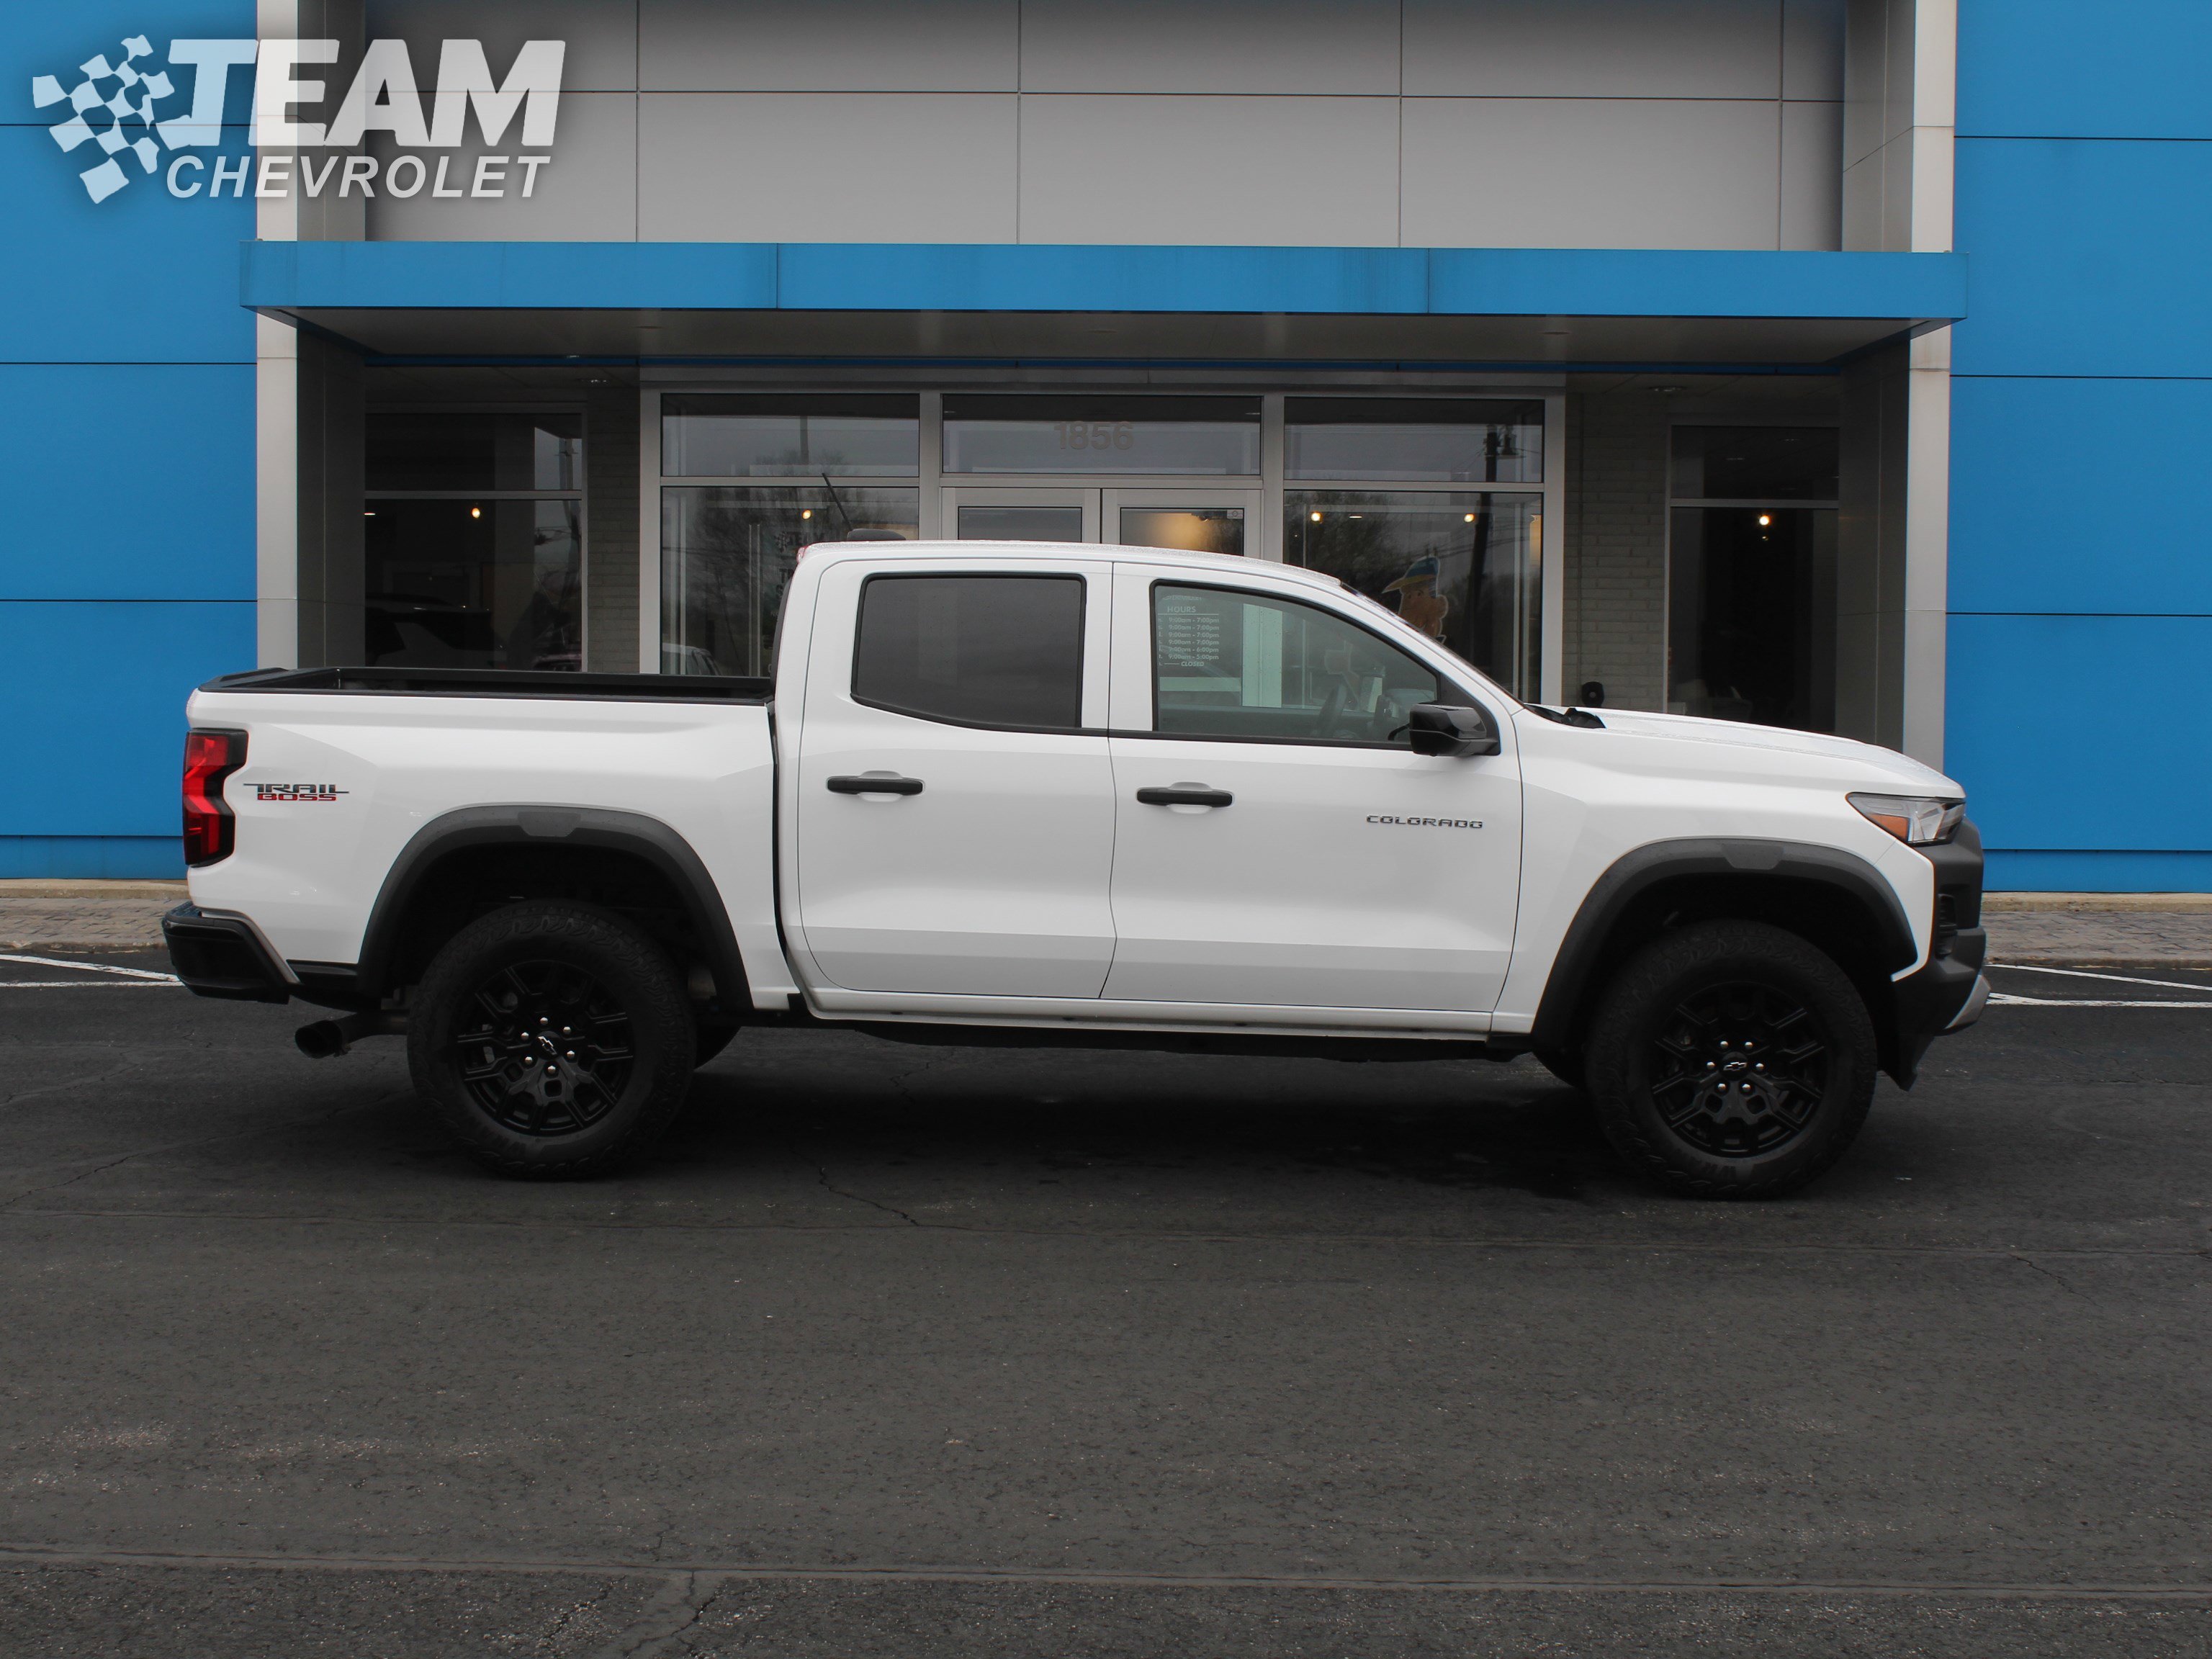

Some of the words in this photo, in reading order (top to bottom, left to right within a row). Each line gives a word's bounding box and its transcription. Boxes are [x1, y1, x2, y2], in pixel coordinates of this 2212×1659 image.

[1054, 421, 1134, 450] 1856
[243, 783, 349, 793] TRAIL
[1367, 814, 1483, 829] COLORADO
